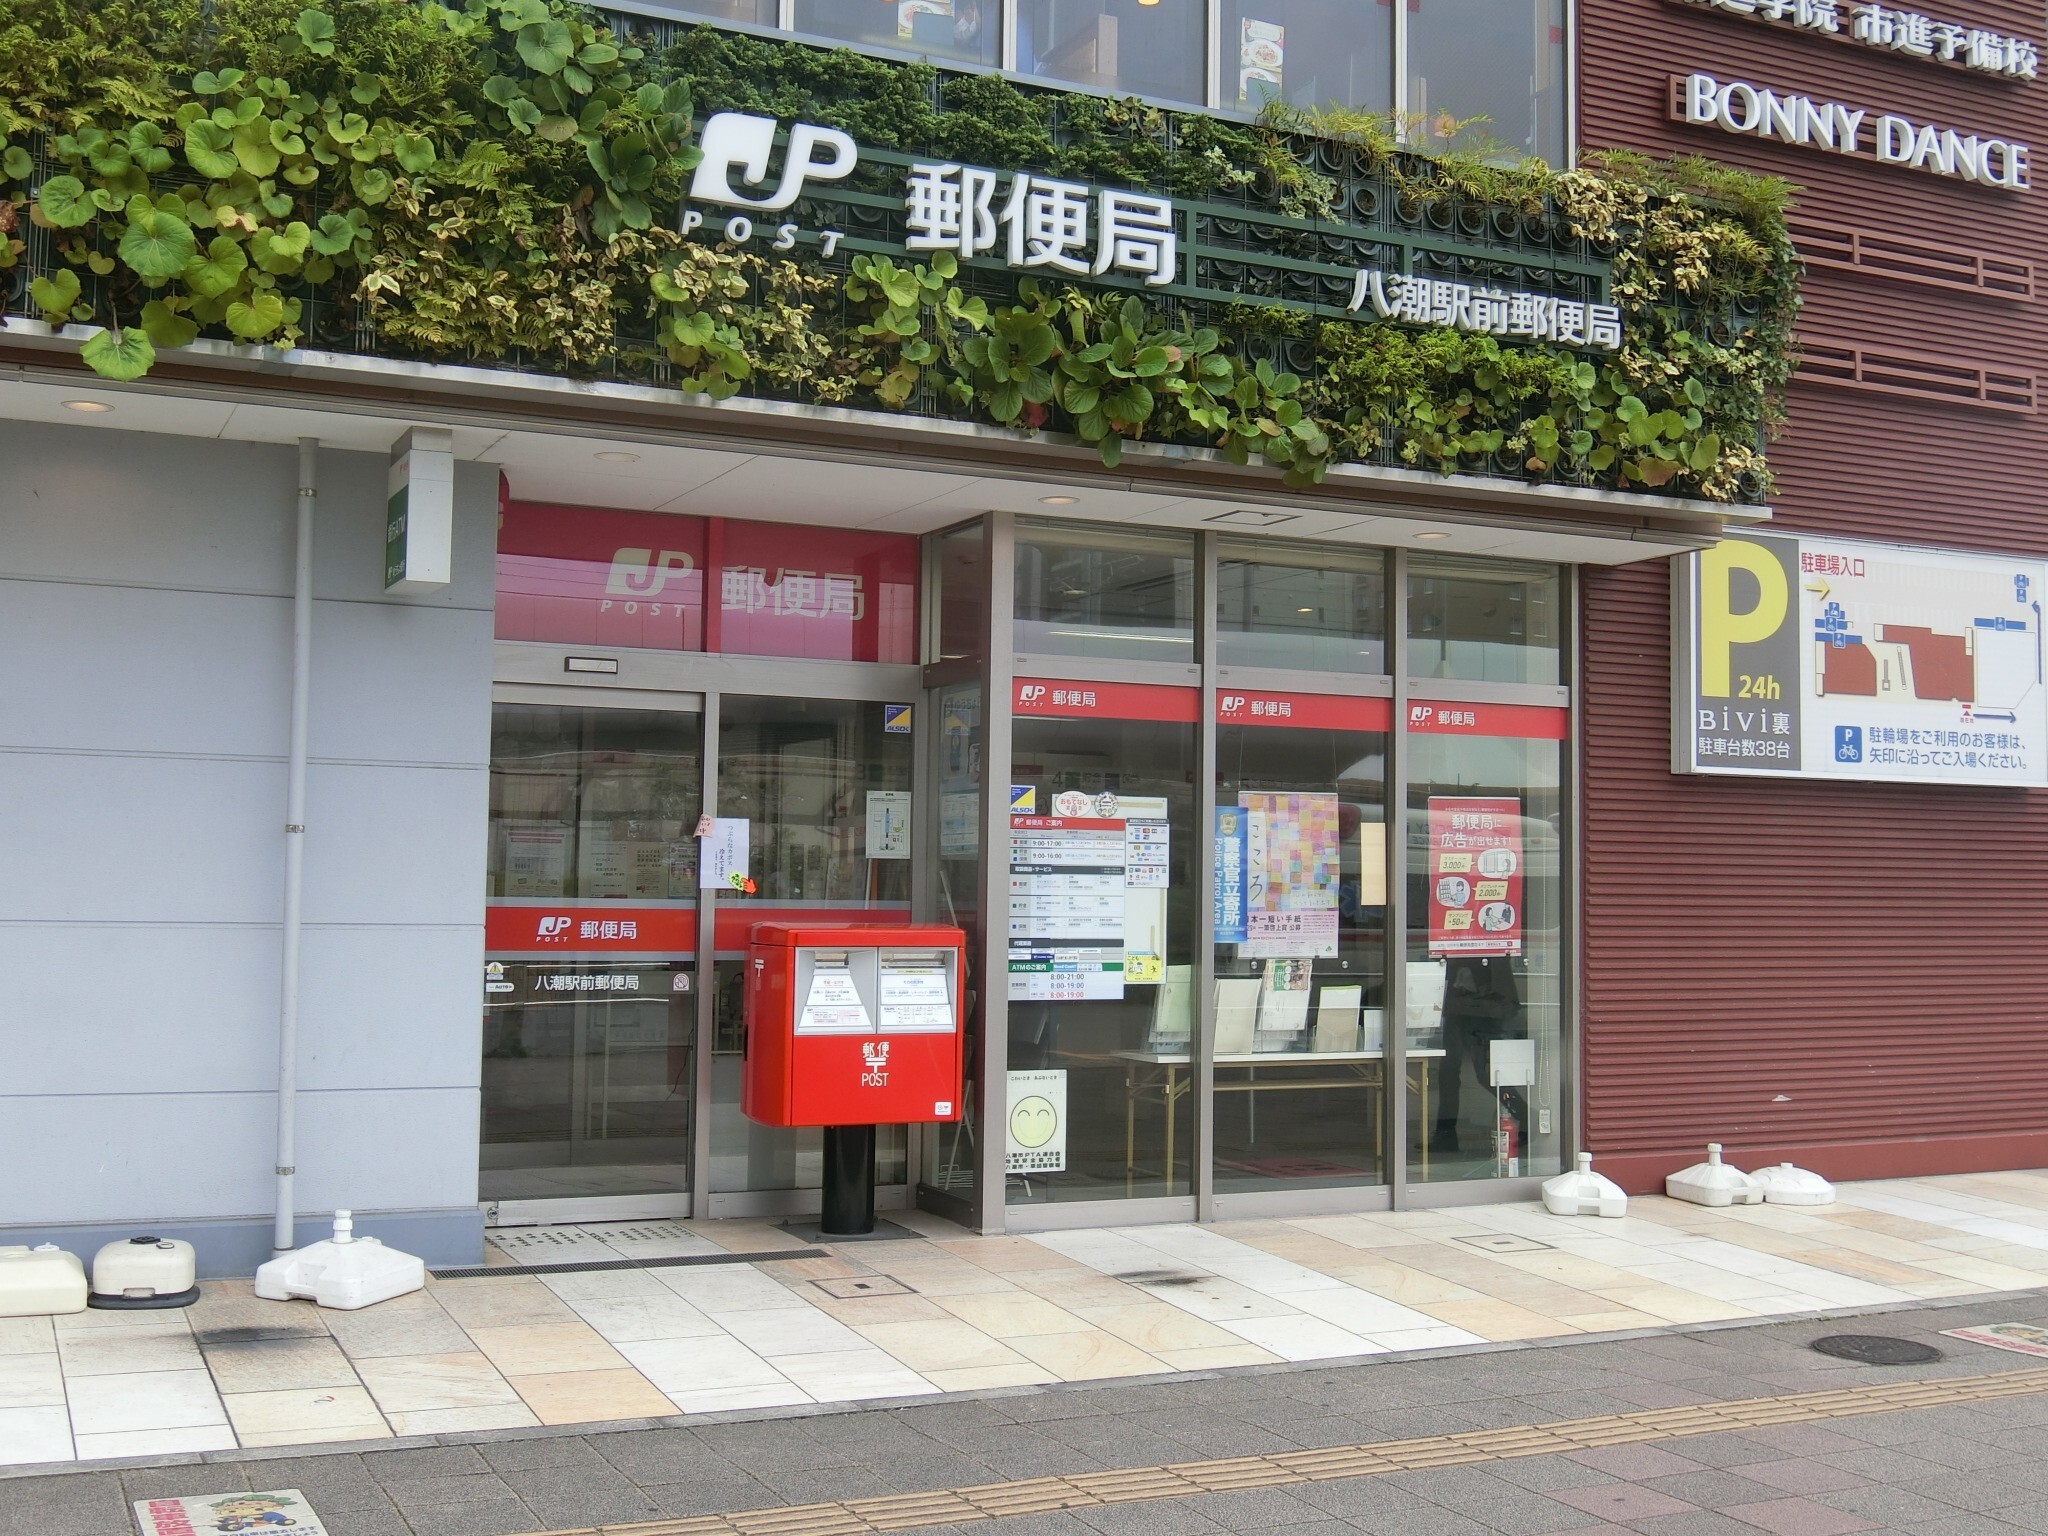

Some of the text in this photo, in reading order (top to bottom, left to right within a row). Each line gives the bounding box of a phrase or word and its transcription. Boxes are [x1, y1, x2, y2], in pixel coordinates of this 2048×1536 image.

[1852, 4, 2038, 80] 市進予備校
[1686, 74, 2030, 190] BONNY DANCE
[690, 112, 857, 211] JP
[681, 209, 844, 258] POST
[906, 163, 1176, 287] 郵便局
[1347, 268, 1622, 350] 八潮駅前郵便局
[605, 547, 694, 596] JP
[1801, 552, 1865, 577] 駐車場入口
[722, 565, 865, 621] 郵便局
[600, 600, 685, 618] POST
[1701, 540, 1788, 697] P
[1020, 685, 1046, 701] JP
[1052, 689, 1096, 707] 郵便局
[1738, 674, 1780, 700] 24h
[1221, 696, 1245, 712] JP
[1250, 700, 1291, 717] 郵便局
[1410, 706, 1433, 721] JP
[1438, 710, 1475, 726] 郵便局
[1698, 737, 1790, 759] 駐車台数38台
[1869, 726, 2027, 750] 駐輪場をご利用のお客様は、
[1869, 746, 2028, 770] 矢印に沿ってご入場ください。
[1060, 798, 1088, 806] おもてなし
[1045, 819, 1063, 827] ご案内
[1451, 814, 1503, 830] 郵便局に
[1214, 837, 1224, 925] Police Patrol Area
[1222, 837, 1241, 926] 警察官立寄所
[537, 916, 572, 936] JP
[580, 920, 638, 940] 郵便局
[534, 974, 640, 991] 八潮駅前郵便局
[862, 1041, 890, 1058] 郵便
[861, 1072, 890, 1087] POST
